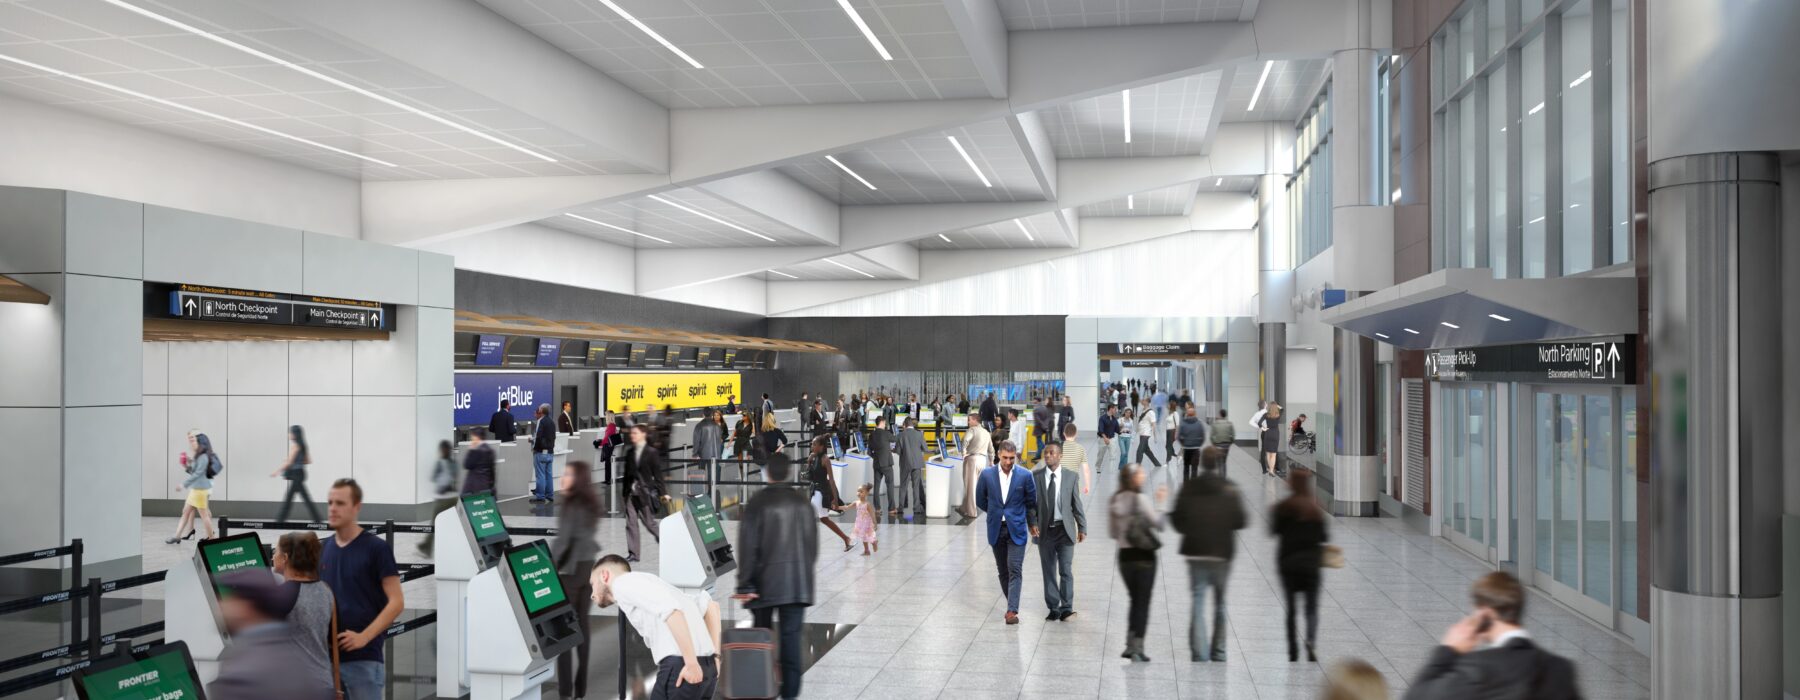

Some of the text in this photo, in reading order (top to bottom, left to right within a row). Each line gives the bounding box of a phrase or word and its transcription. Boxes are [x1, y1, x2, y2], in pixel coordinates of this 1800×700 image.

[215, 301, 278, 315] North Checkpoint
[310, 308, 359, 321] Main Checkpoint
[1437, 350, 1477, 368] Passenger Pick-Up
[1538, 343, 1590, 366] North Parking
[1578, 368, 1591, 379] Norte
[497, 385, 534, 412] jetBlue
[620, 382, 733, 403] spirit spirit spirit spirit
[34, 549, 57, 557] FRONTIER
[222, 546, 244, 556] FRONTIER
[217, 563, 227, 571] Self
[235, 561, 246, 569] your
[42, 591, 70, 603] FRONTIER
[41, 646, 69, 659] FRONTIER
[55, 660, 91, 676] FRONTIER
[118, 669, 159, 690] FRONTIER
[163, 689, 184, 700] bags
